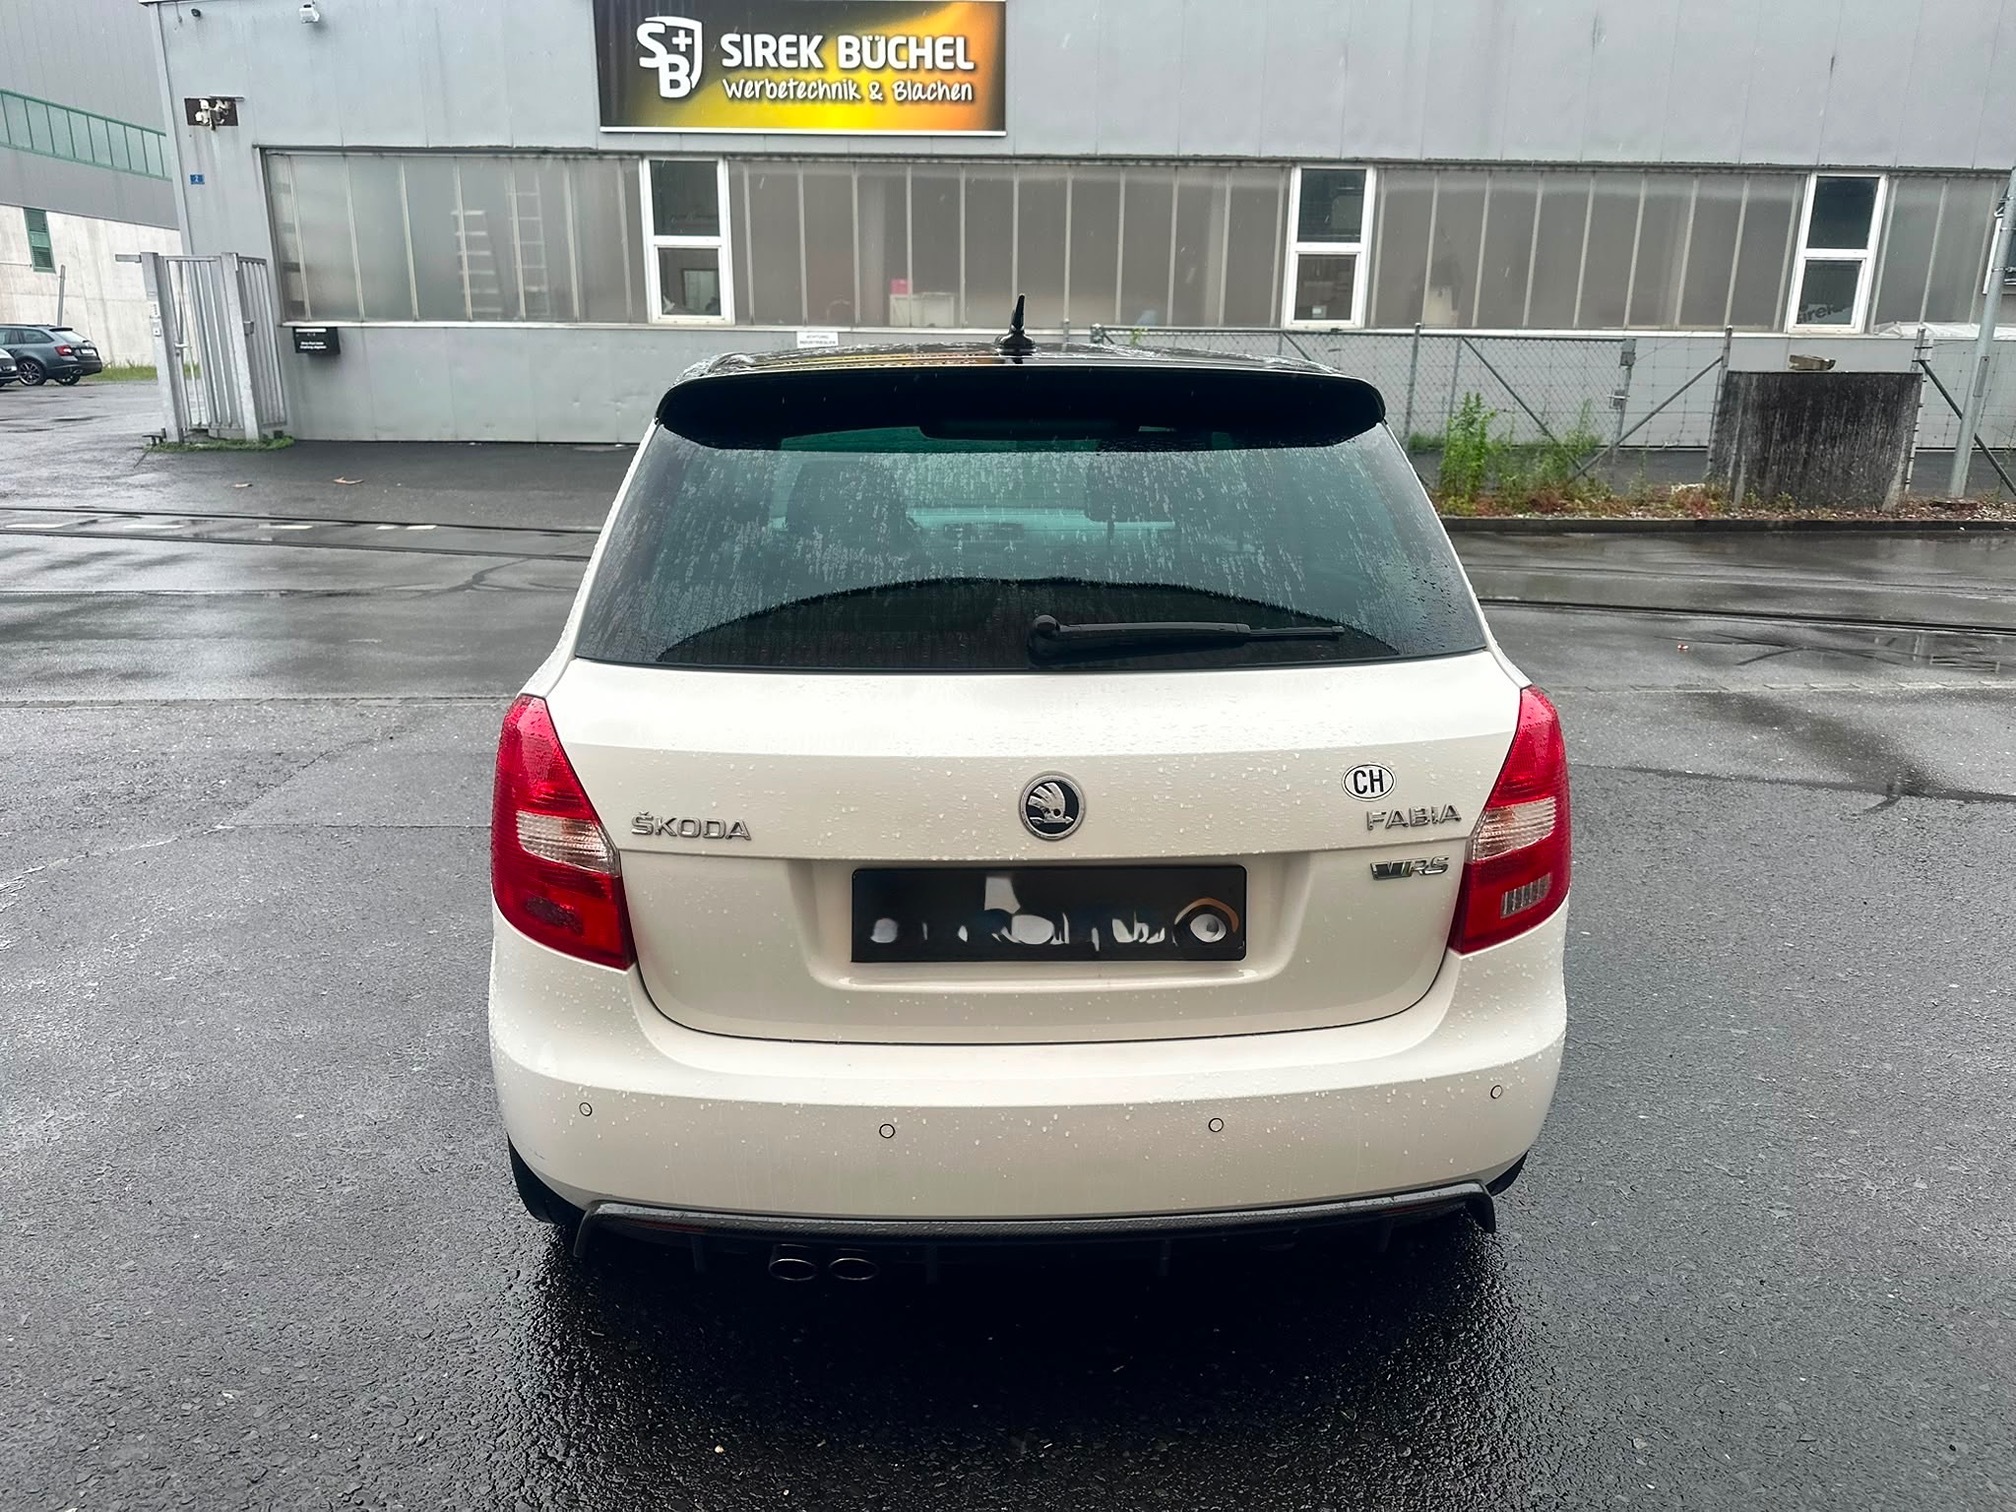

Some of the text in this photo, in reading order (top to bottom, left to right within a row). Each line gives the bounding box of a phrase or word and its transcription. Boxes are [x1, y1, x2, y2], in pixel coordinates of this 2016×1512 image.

[720, 33, 975, 70] SIREK BÜCHEL
[722, 78, 973, 101] Werbetechnik & Blachen
[1353, 769, 1384, 794] CH
[631, 811, 752, 841] ŠKODA
[1366, 804, 1462, 831] FABIA
